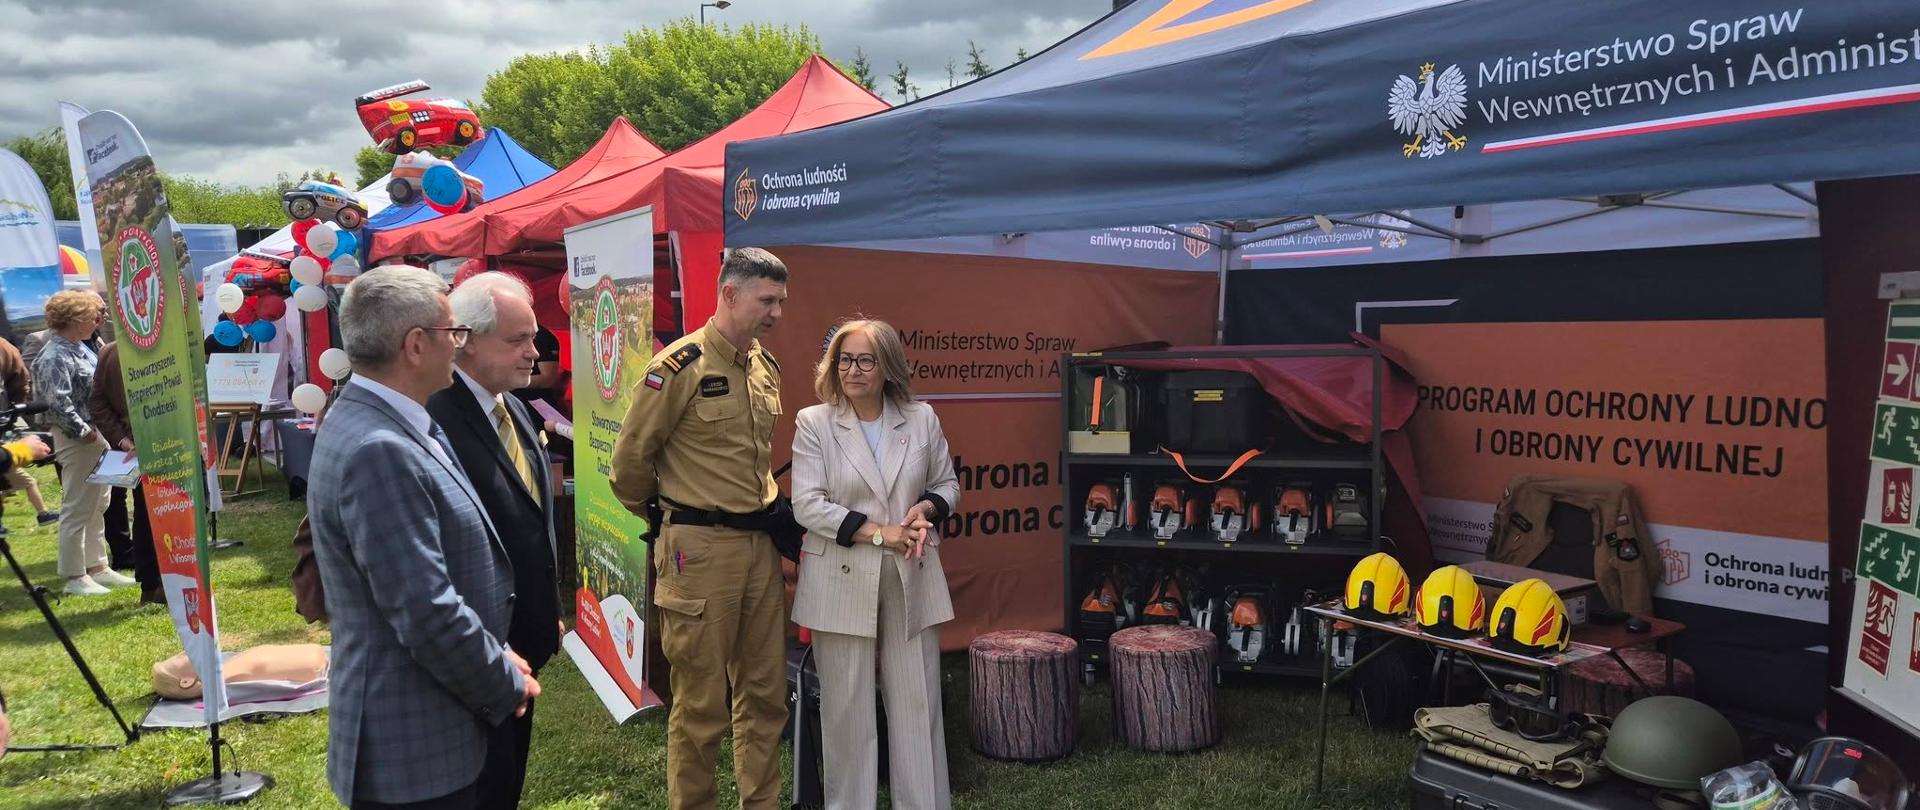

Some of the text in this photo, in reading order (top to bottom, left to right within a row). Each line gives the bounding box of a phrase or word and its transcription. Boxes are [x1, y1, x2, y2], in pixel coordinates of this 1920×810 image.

[1477, 8, 1804, 89] Ministerstwo Spraw
[1478, 28, 1920, 124] Wewnętrznych i Administ
[762, 162, 847, 190] Ochrona ludności
[762, 187, 840, 210] i obrona cywilna
[899, 329, 1076, 355] Ministerstwo Spraw
[128, 352, 176, 382] Stowarzyszenie
[1039, 358, 1044, 378] i
[163, 371, 183, 391] Powiat
[143, 396, 178, 420] Chodzieski
[1416, 384, 1828, 430] PROGRAM OCHRONY LUDNO
[1475, 427, 1785, 478] I OBRONY CYWILNEJ
[1704, 551, 1785, 577] Ochrona
[1704, 569, 1710, 584] i
[1713, 572, 1780, 595] obrona
